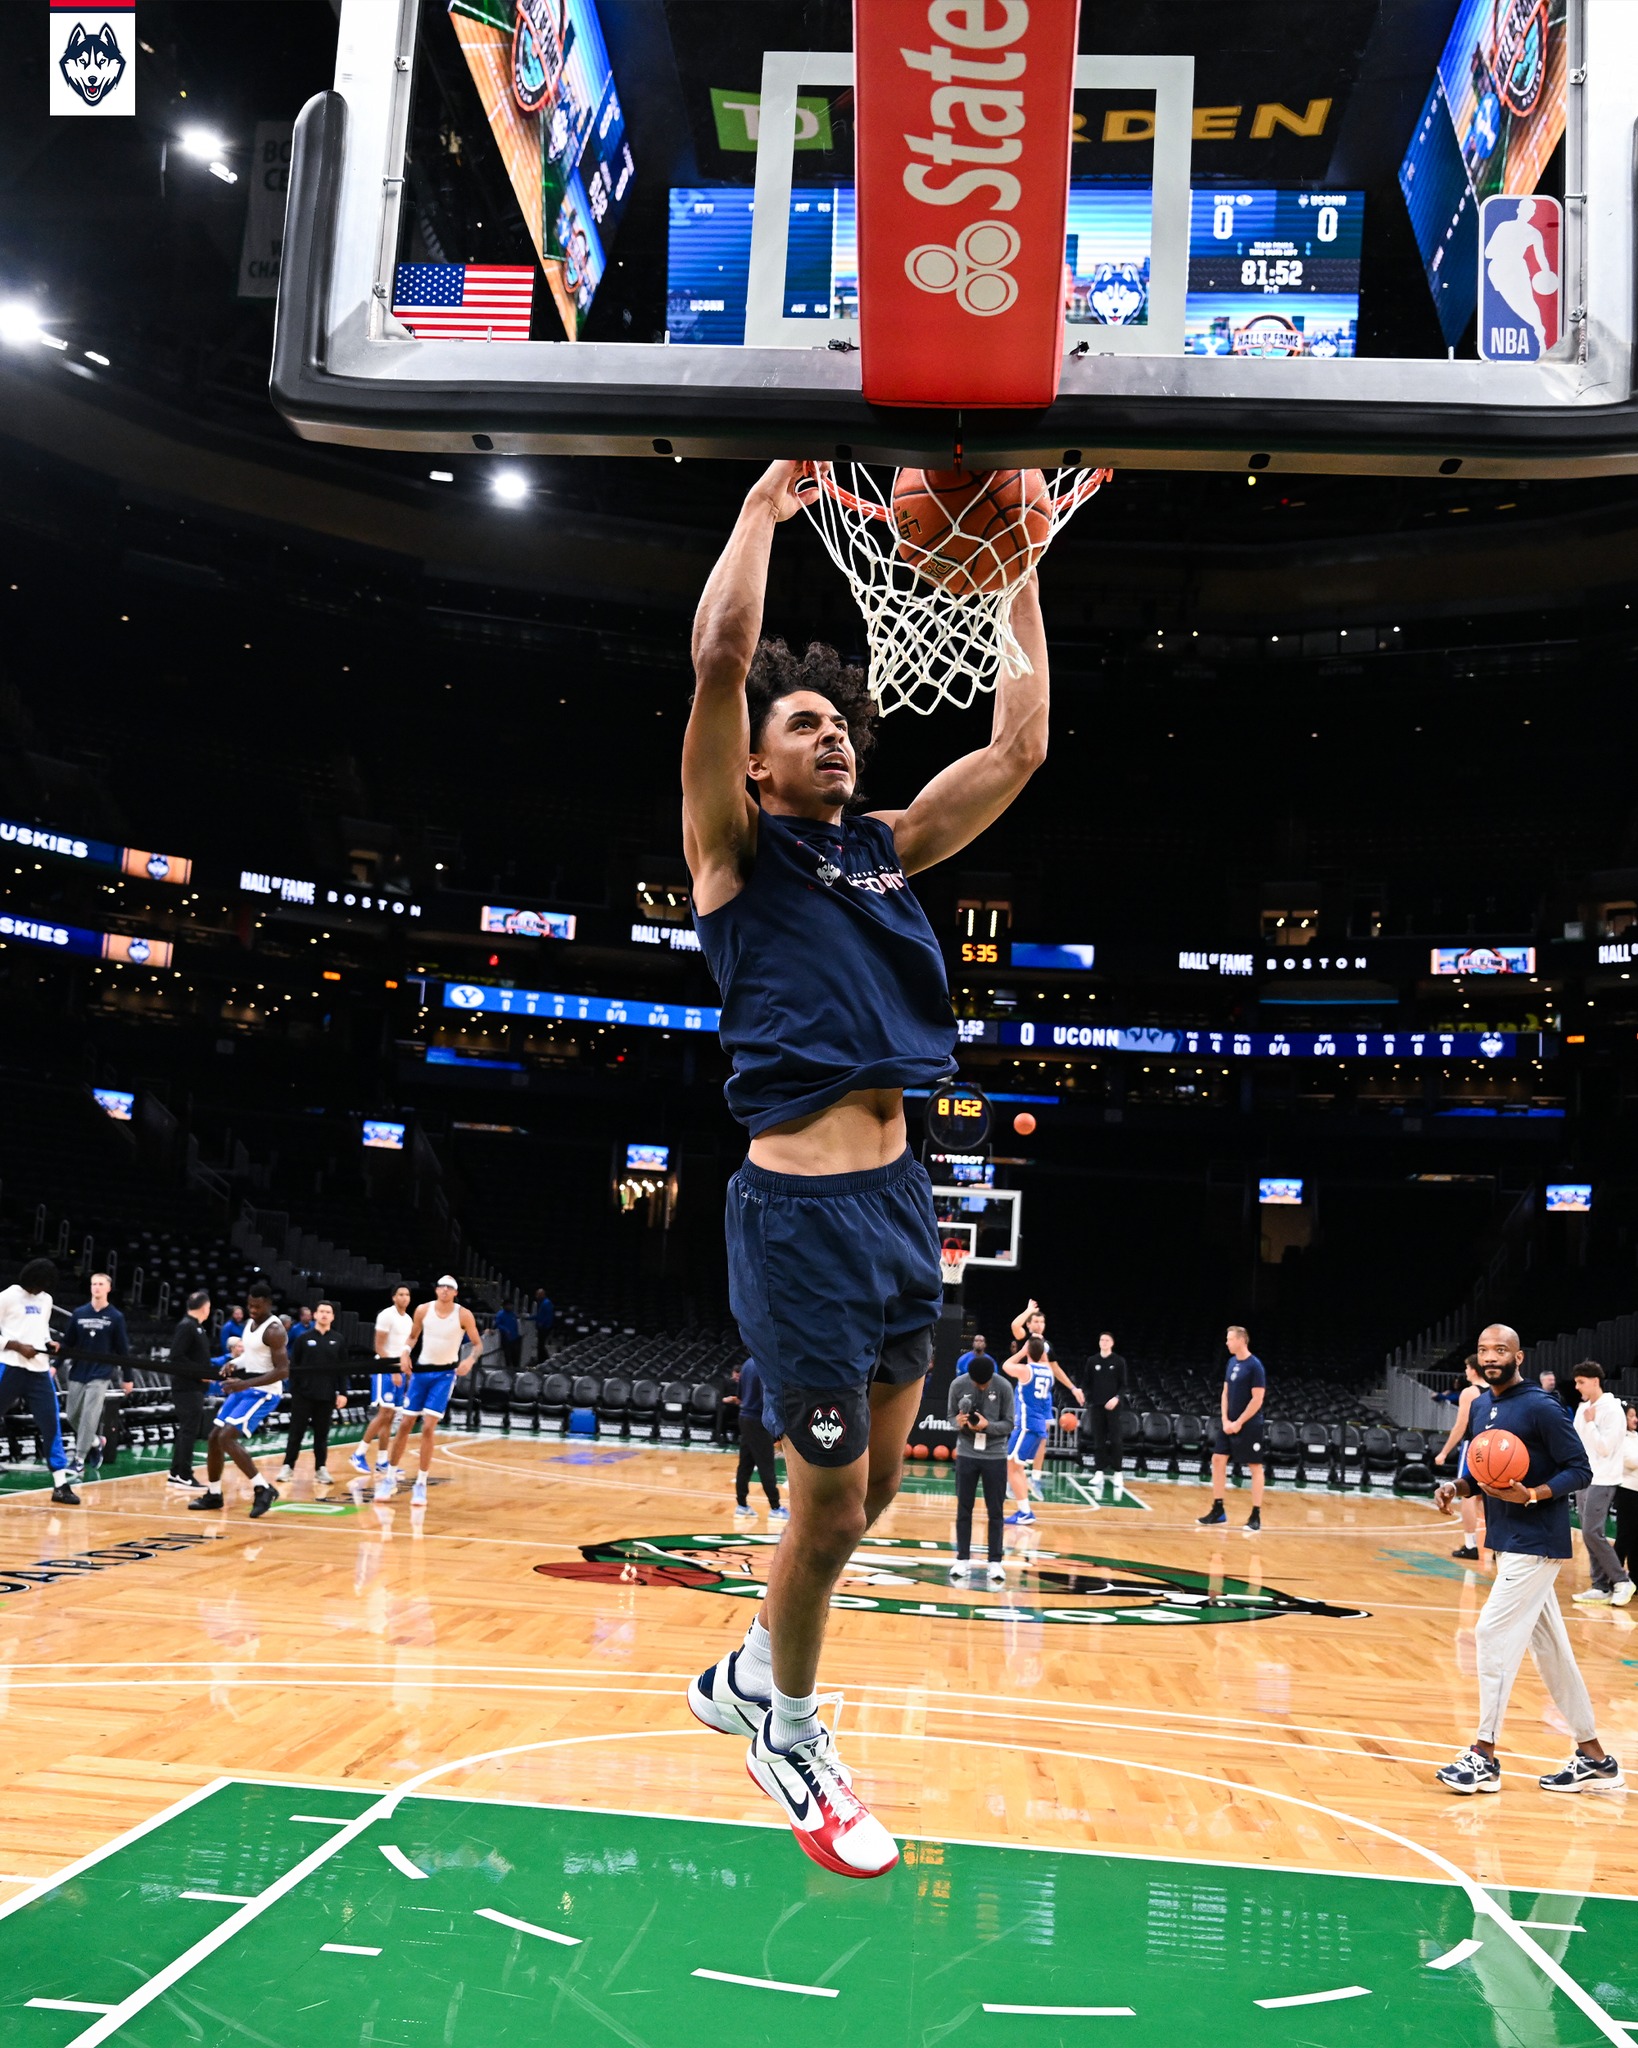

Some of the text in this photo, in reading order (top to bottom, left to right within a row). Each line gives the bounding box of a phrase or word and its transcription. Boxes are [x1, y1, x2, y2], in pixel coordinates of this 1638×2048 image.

[900, 0, 1029, 211] State
[1072, 97, 1333, 143] RDEN
[1310, 194, 1348, 207] UCONN
[1213, 205, 1234, 240] 0
[1317, 207, 1339, 243] 0
[1241, 260, 1304, 286] 81:52
[689, 299, 725, 312] UCONN
[1491, 327, 1530, 355] NBA
[0, 822, 88, 859] USKIES
[240, 870, 271, 894] HALL
[271, 876, 282, 890] OF
[281, 878, 316, 901] FAME
[327, 890, 421, 917] BOSTON
[0, 916, 69, 946] SKIES
[631, 924, 661, 944] HALL
[670, 928, 701, 948] FAM
[961, 943, 998, 963] 5:35
[1178, 951, 1254, 972] HALL OF FAME
[1266, 957, 1367, 970] BOSTON
[1598, 943, 1632, 964] HALL
[957, 1019, 985, 1036] 1:52
[1020, 1022, 1035, 1046] 0
[1053, 1026, 1119, 1047] UCONN
[1268, 1042, 1291, 1057] 0/0
[1313, 1042, 1336, 1056] 0/0
[944, 1154, 985, 1165] TISSOT
[1033, 1376, 1051, 1400] 51
